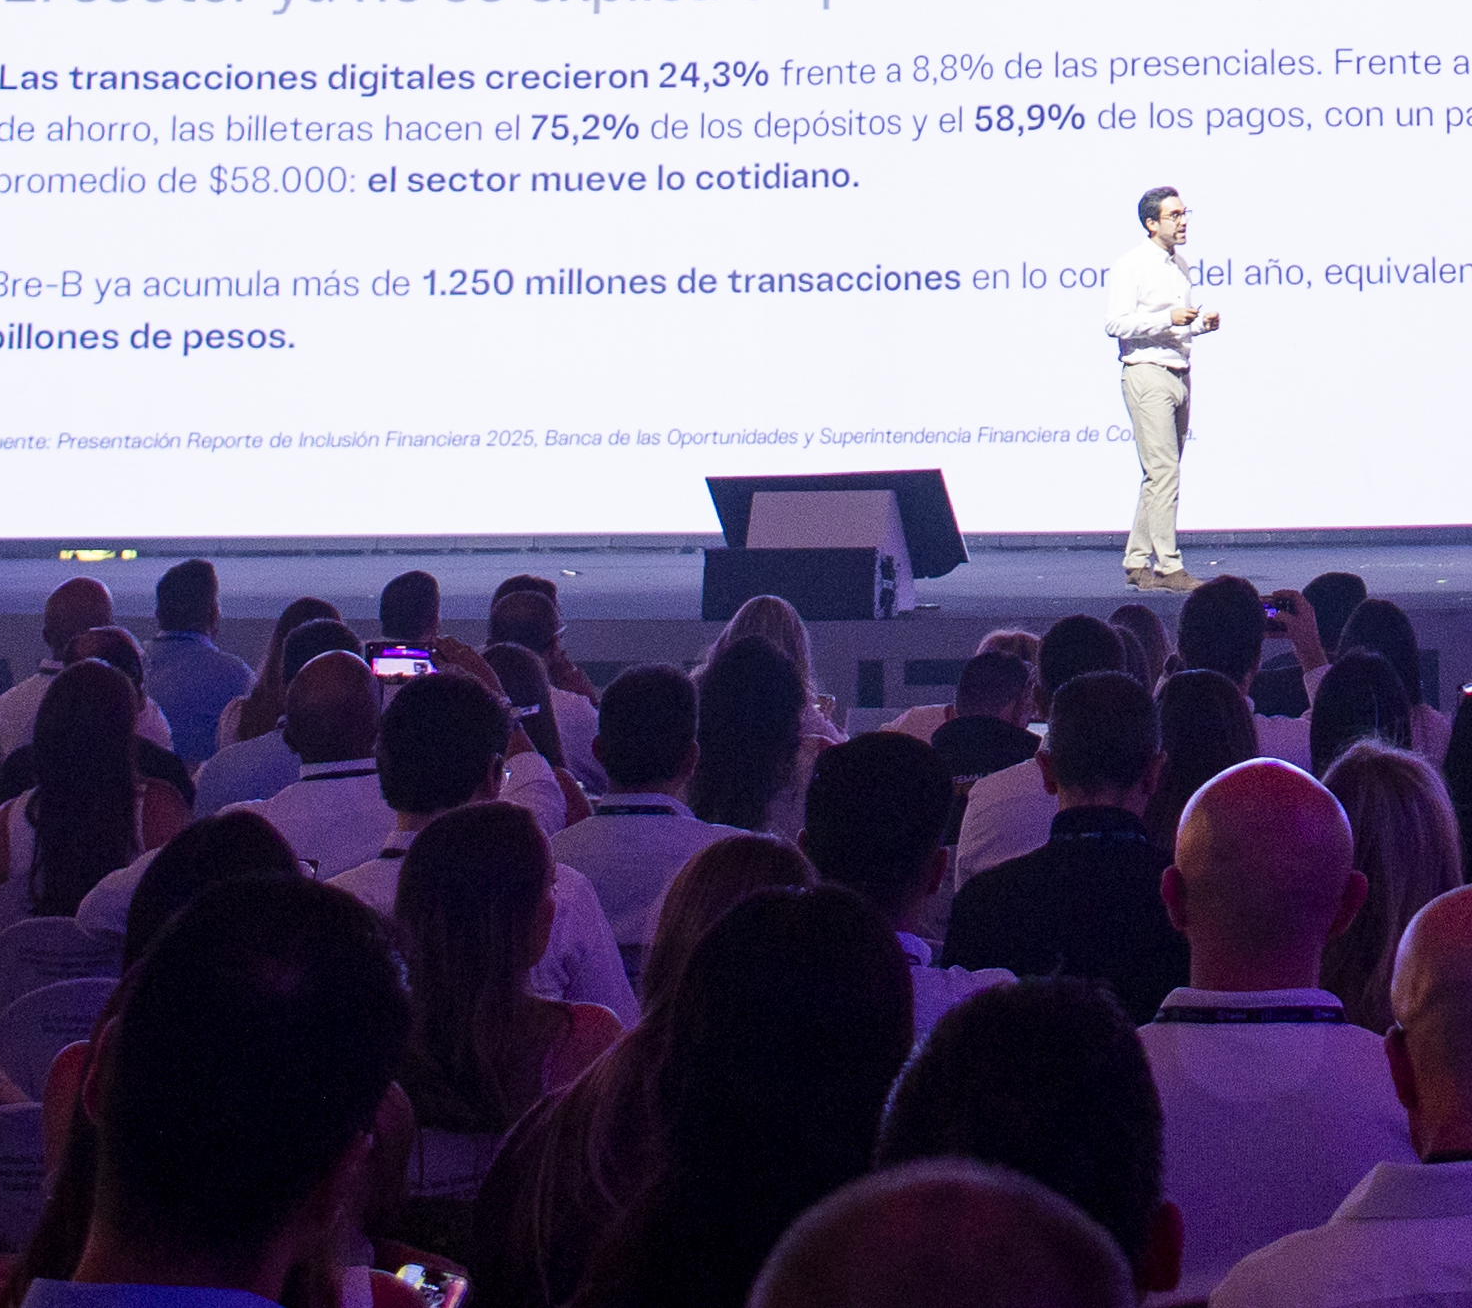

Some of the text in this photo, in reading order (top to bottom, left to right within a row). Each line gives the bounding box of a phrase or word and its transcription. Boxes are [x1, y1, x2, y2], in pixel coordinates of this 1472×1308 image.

[0, 64, 58, 90] Las
[69, 64, 317, 90] transacciones
[328, 64, 475, 97] digitales
[486, 63, 648, 90] crecieron
[659, 61, 769, 93] 24,3%
[780, 59, 876, 86] frente
[886, 63, 901, 83] a
[913, 53, 994, 85] 8,8%
[1004, 52, 1042, 79] de
[1055, 51, 1097, 78] las
[1110, 48, 1322, 84] presenciales.
[1335, 48, 1441, 75] Frente
[1453, 55, 1469, 75] a
[94, 277, 131, 305] ya
[143, 270, 280, 297] acumula
[293, 270, 359, 297] más
[371, 269, 410, 296] de
[423, 269, 514, 296] 1.250
[526, 268, 666, 295] millones
[677, 267, 717, 294] de
[728, 264, 961, 293] transacciones
[972, 269, 1009, 290] en
[1022, 262, 1047, 289] lo
[1188, 258, 1231, 288] del
[1245, 259, 1312, 289] año,
[130, 322, 172, 349] de
[183, 329, 294, 357] pesos.
[57, 432, 181, 450] Presentación
[187, 432, 263, 453] Reporte
[269, 432, 293, 448] de
[298, 431, 380, 448] Inclusión
[385, 430, 481, 447] Financiera
[486, 429, 538, 448] 2025,
[545, 429, 602, 446] Banca
[608, 429, 631, 446] de
[636, 429, 661, 446] las
[667, 428, 798, 449] Oportunidades
[803, 432, 815, 449] y
[819, 427, 971, 448] Superintendencia
[977, 426, 1070, 443] Financiera
[1076, 426, 1100, 443] de
